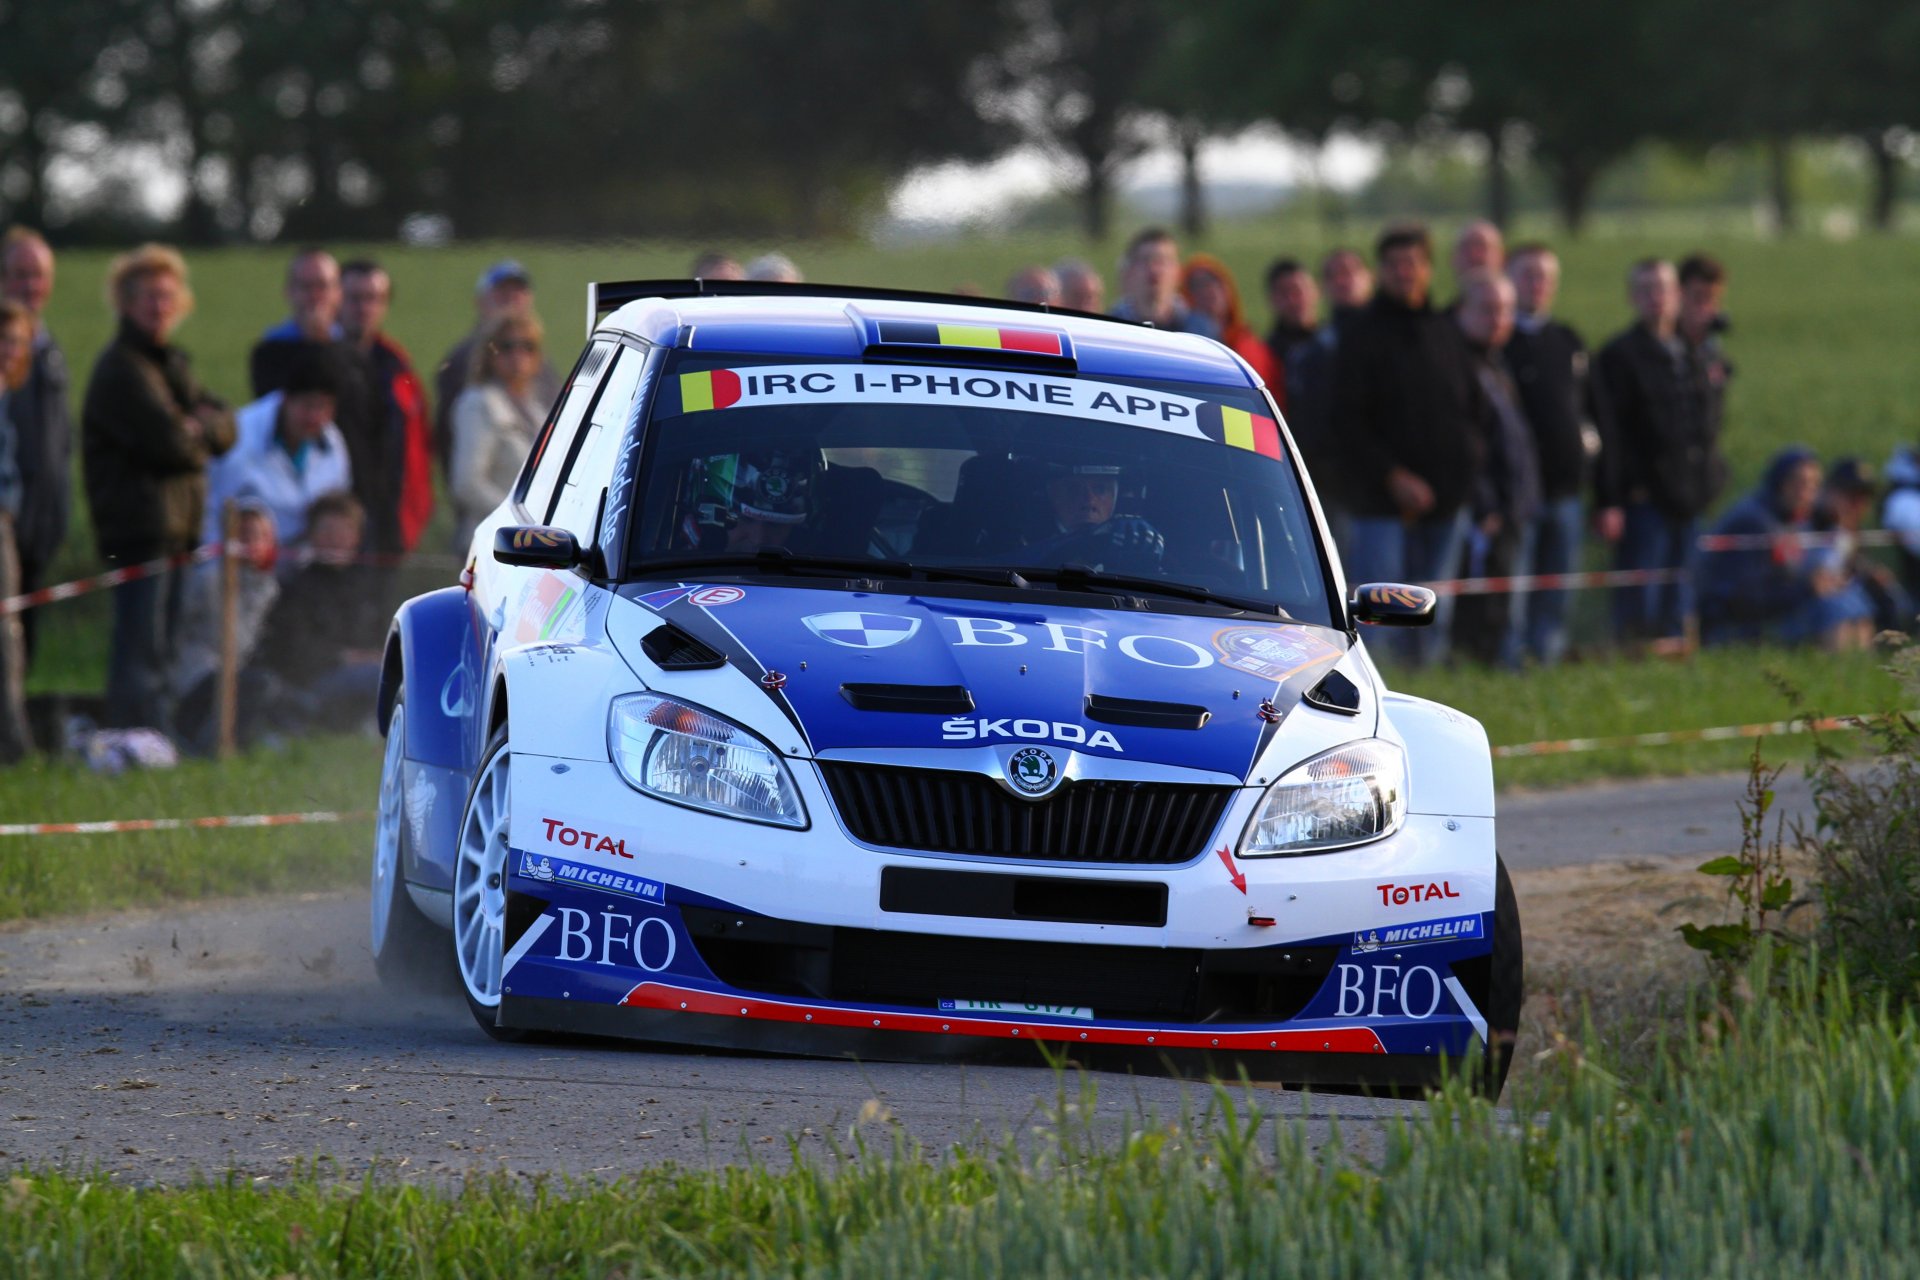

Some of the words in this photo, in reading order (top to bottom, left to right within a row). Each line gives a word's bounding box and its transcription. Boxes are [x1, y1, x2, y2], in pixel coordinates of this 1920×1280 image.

[748, 372, 836, 396] IRC
[854, 372, 1073, 406] I-PHONE
[1089, 390, 1191, 423] APP
[699, 589, 736, 602] E
[943, 616, 1214, 668] BFO
[942, 716, 1124, 752] ŠKODA
[542, 818, 634, 859] TOTAL
[558, 864, 658, 897] MICHELIN
[1377, 881, 1460, 906] TOTAL
[555, 907, 676, 972] BFO
[1384, 919, 1475, 943] MICHELIN
[1334, 964, 1441, 1019] BFO
